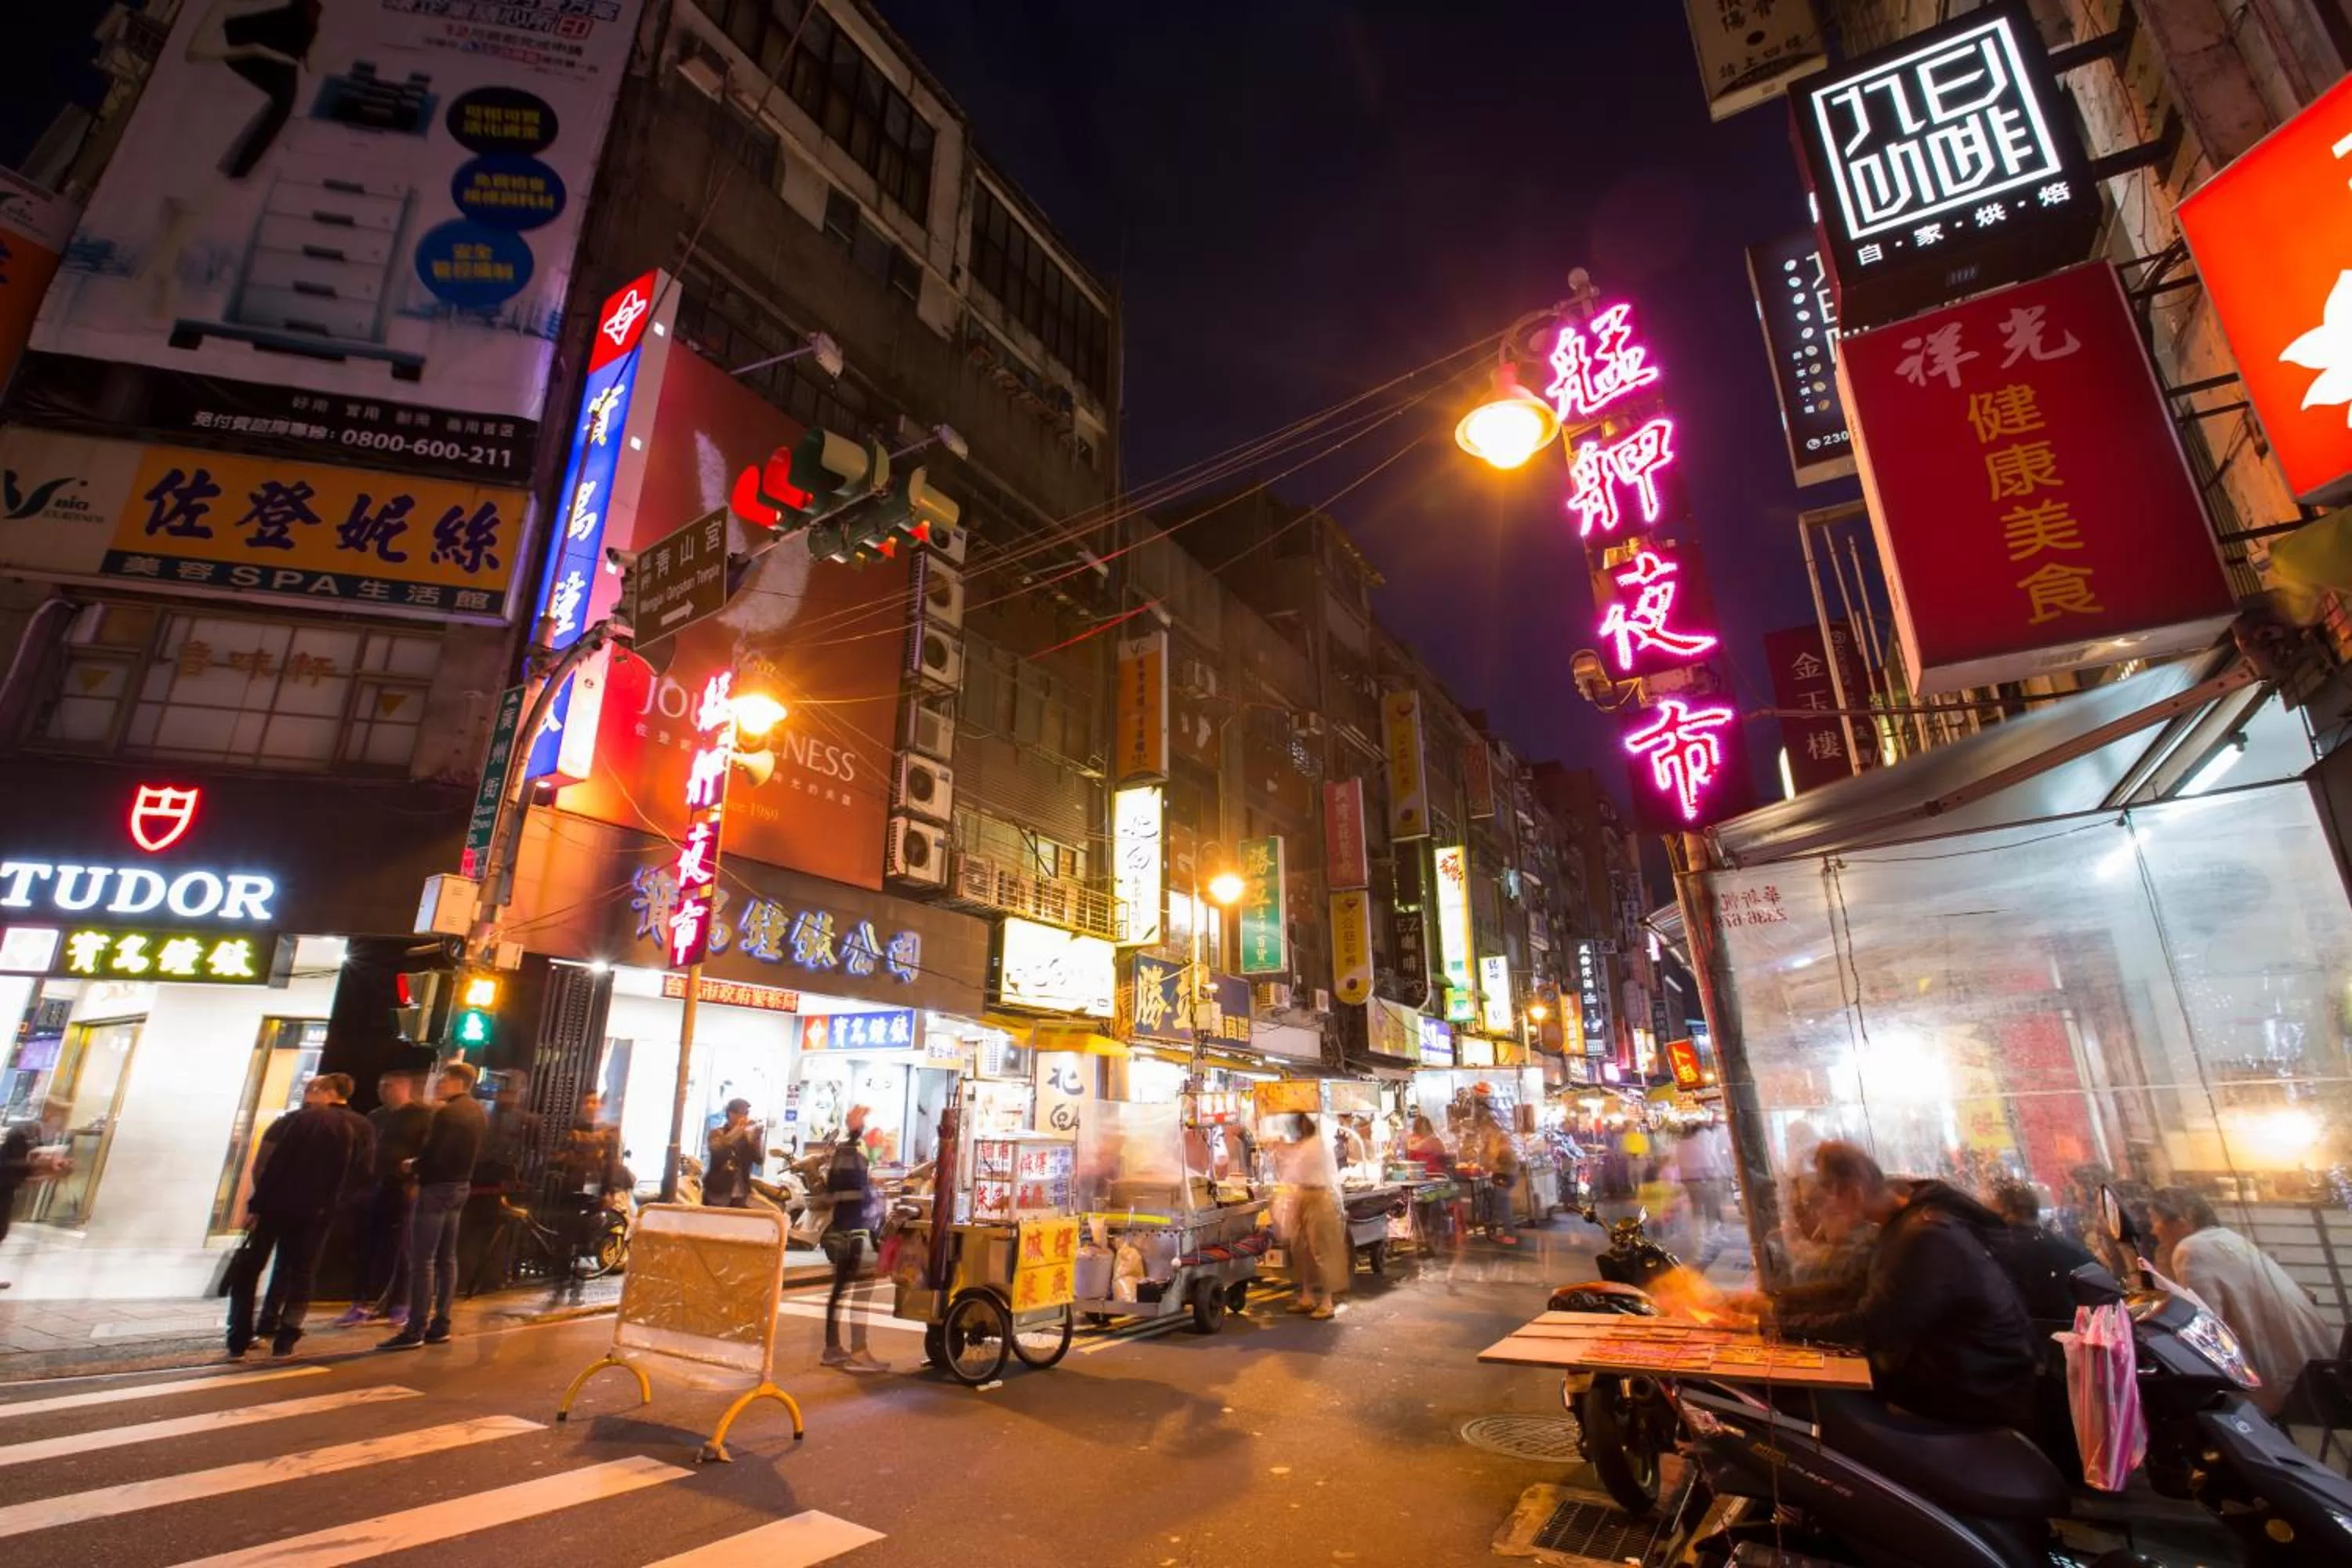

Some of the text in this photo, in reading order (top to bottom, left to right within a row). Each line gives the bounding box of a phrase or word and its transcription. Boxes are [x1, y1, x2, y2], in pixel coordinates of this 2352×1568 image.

[1848, 106, 2037, 223] 咖啡
[340, 429, 511, 469] 0800-600-211
[143, 468, 503, 575] 佐登妮絲
[654, 520, 722, 578] 青山宮
[1967, 383, 2104, 626] 健康美食
[1546, 303, 1733, 821] 艋舺夜市
[1791, 652, 1845, 761] 金玉樓
[0, 862, 275, 920] TUDOR
[664, 976, 800, 1012] 台市政府警察局
